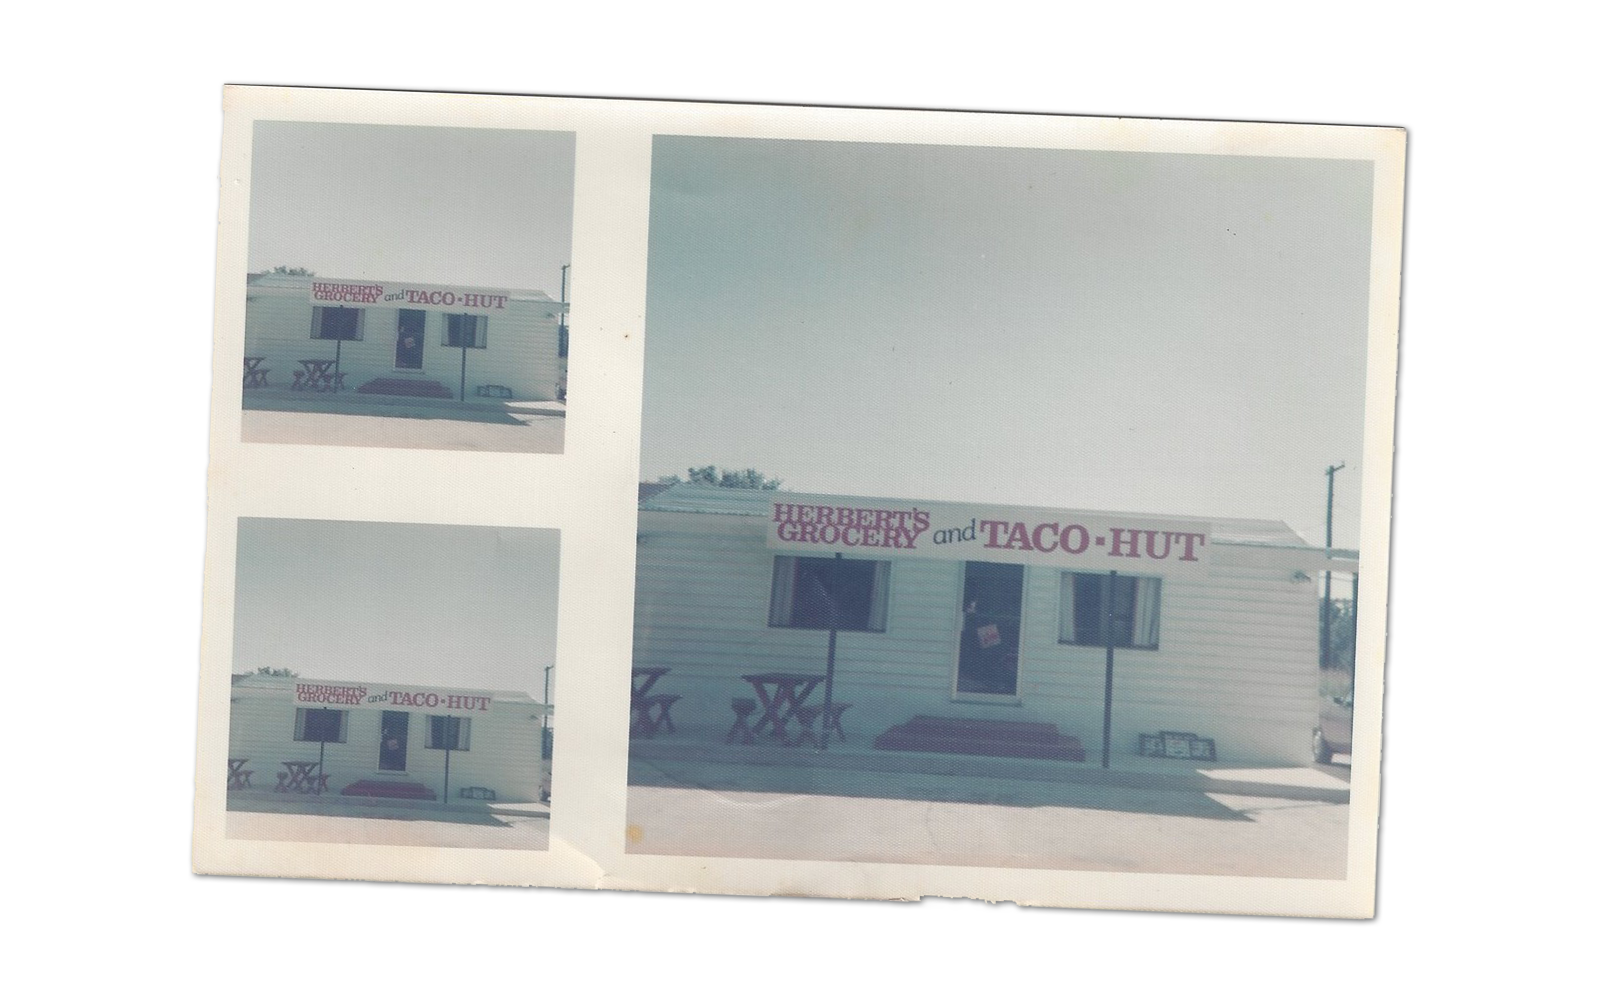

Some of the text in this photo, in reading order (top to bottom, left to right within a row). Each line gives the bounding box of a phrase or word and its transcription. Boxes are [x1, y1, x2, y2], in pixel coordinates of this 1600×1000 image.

[314, 291, 381, 303] GROCERY
[384, 289, 405, 302] and
[771, 503, 930, 533] HERBERT'S
[777, 522, 926, 549] GROCERY
[933, 518, 1206, 562] and TACO HUT
[298, 692, 364, 705] GROCERY
[367, 690, 388, 703] and
